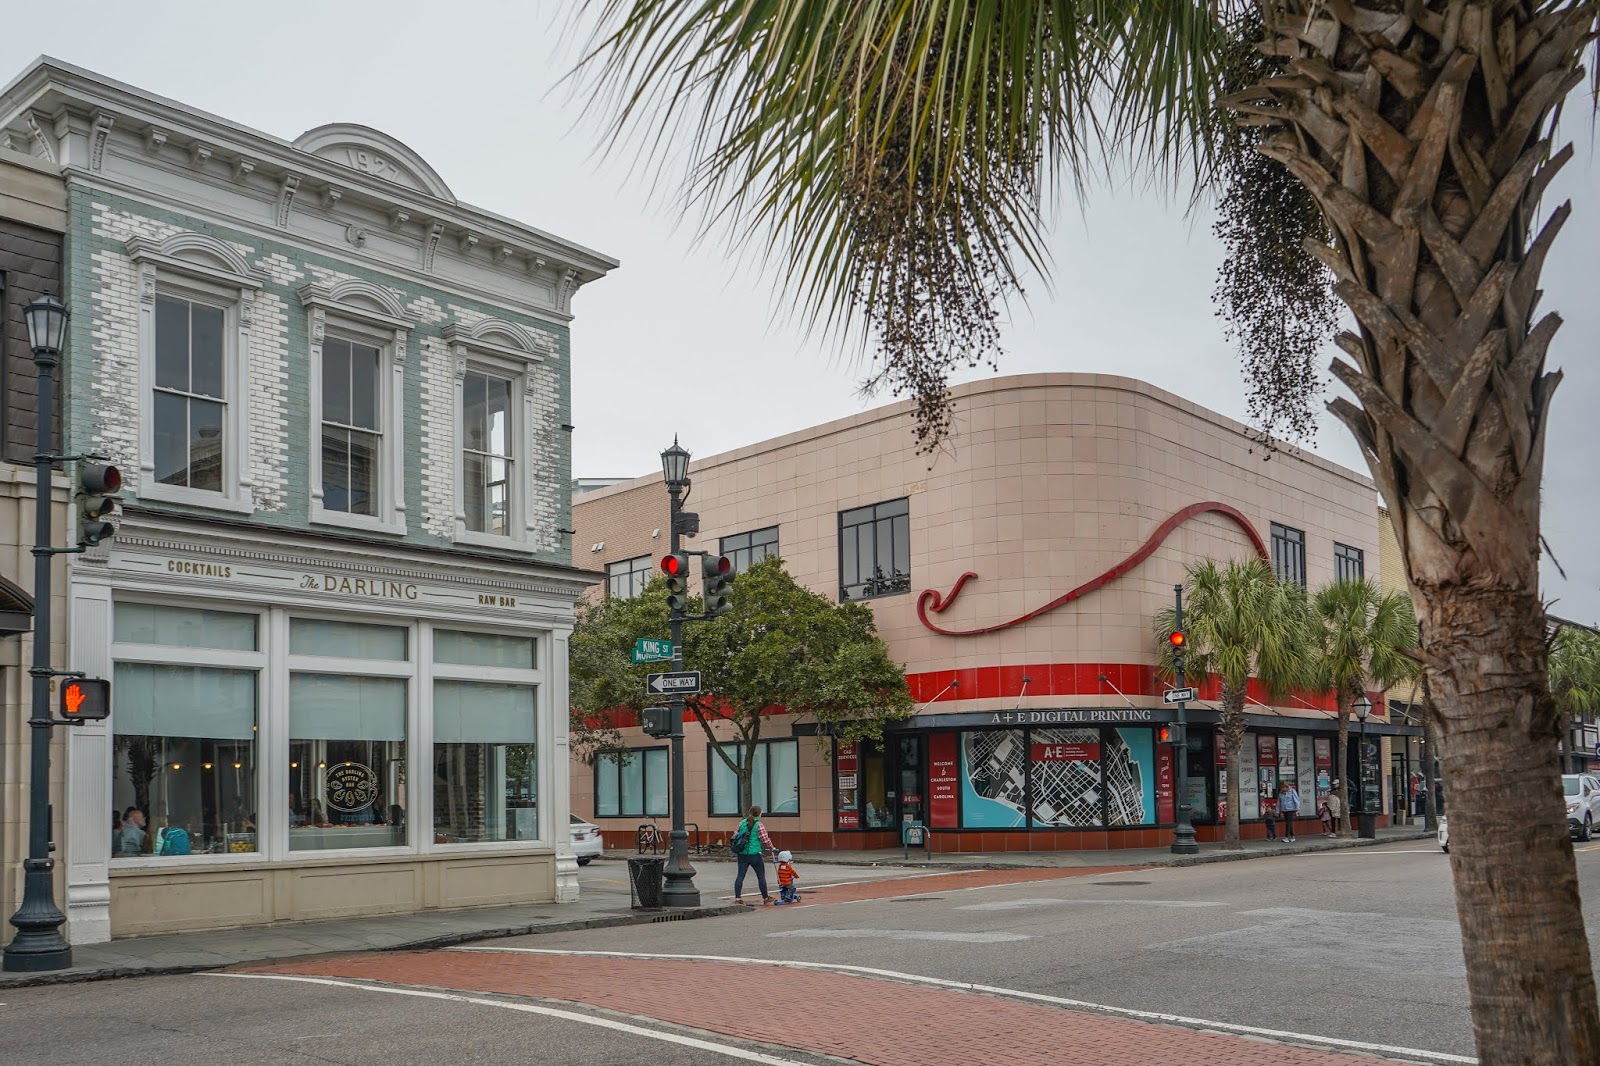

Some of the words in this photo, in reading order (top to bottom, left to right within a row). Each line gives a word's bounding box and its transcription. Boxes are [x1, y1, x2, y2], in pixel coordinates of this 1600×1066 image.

[346, 149, 400, 182] 1927
[168, 560, 231, 578] COCKTAILS
[300, 574, 320, 590] The
[324, 575, 418, 600] DARLING
[478, 594, 496, 605] RAW
[499, 597, 516, 607] BAR
[642, 640, 660, 654] KING
[662, 644, 669, 653] ST
[662, 679, 677, 688] ONE
[679, 677, 694, 687] WAY
[991, 714, 1001, 723] A
[1017, 712, 1026, 723] E
[1030, 711, 1088, 723] DIGITAL
[1090, 710, 1151, 721] PRINTING
[1044, 746, 1063, 759] A+E
[335, 770, 345, 778] THE
[345, 769, 365, 778] DARLING
